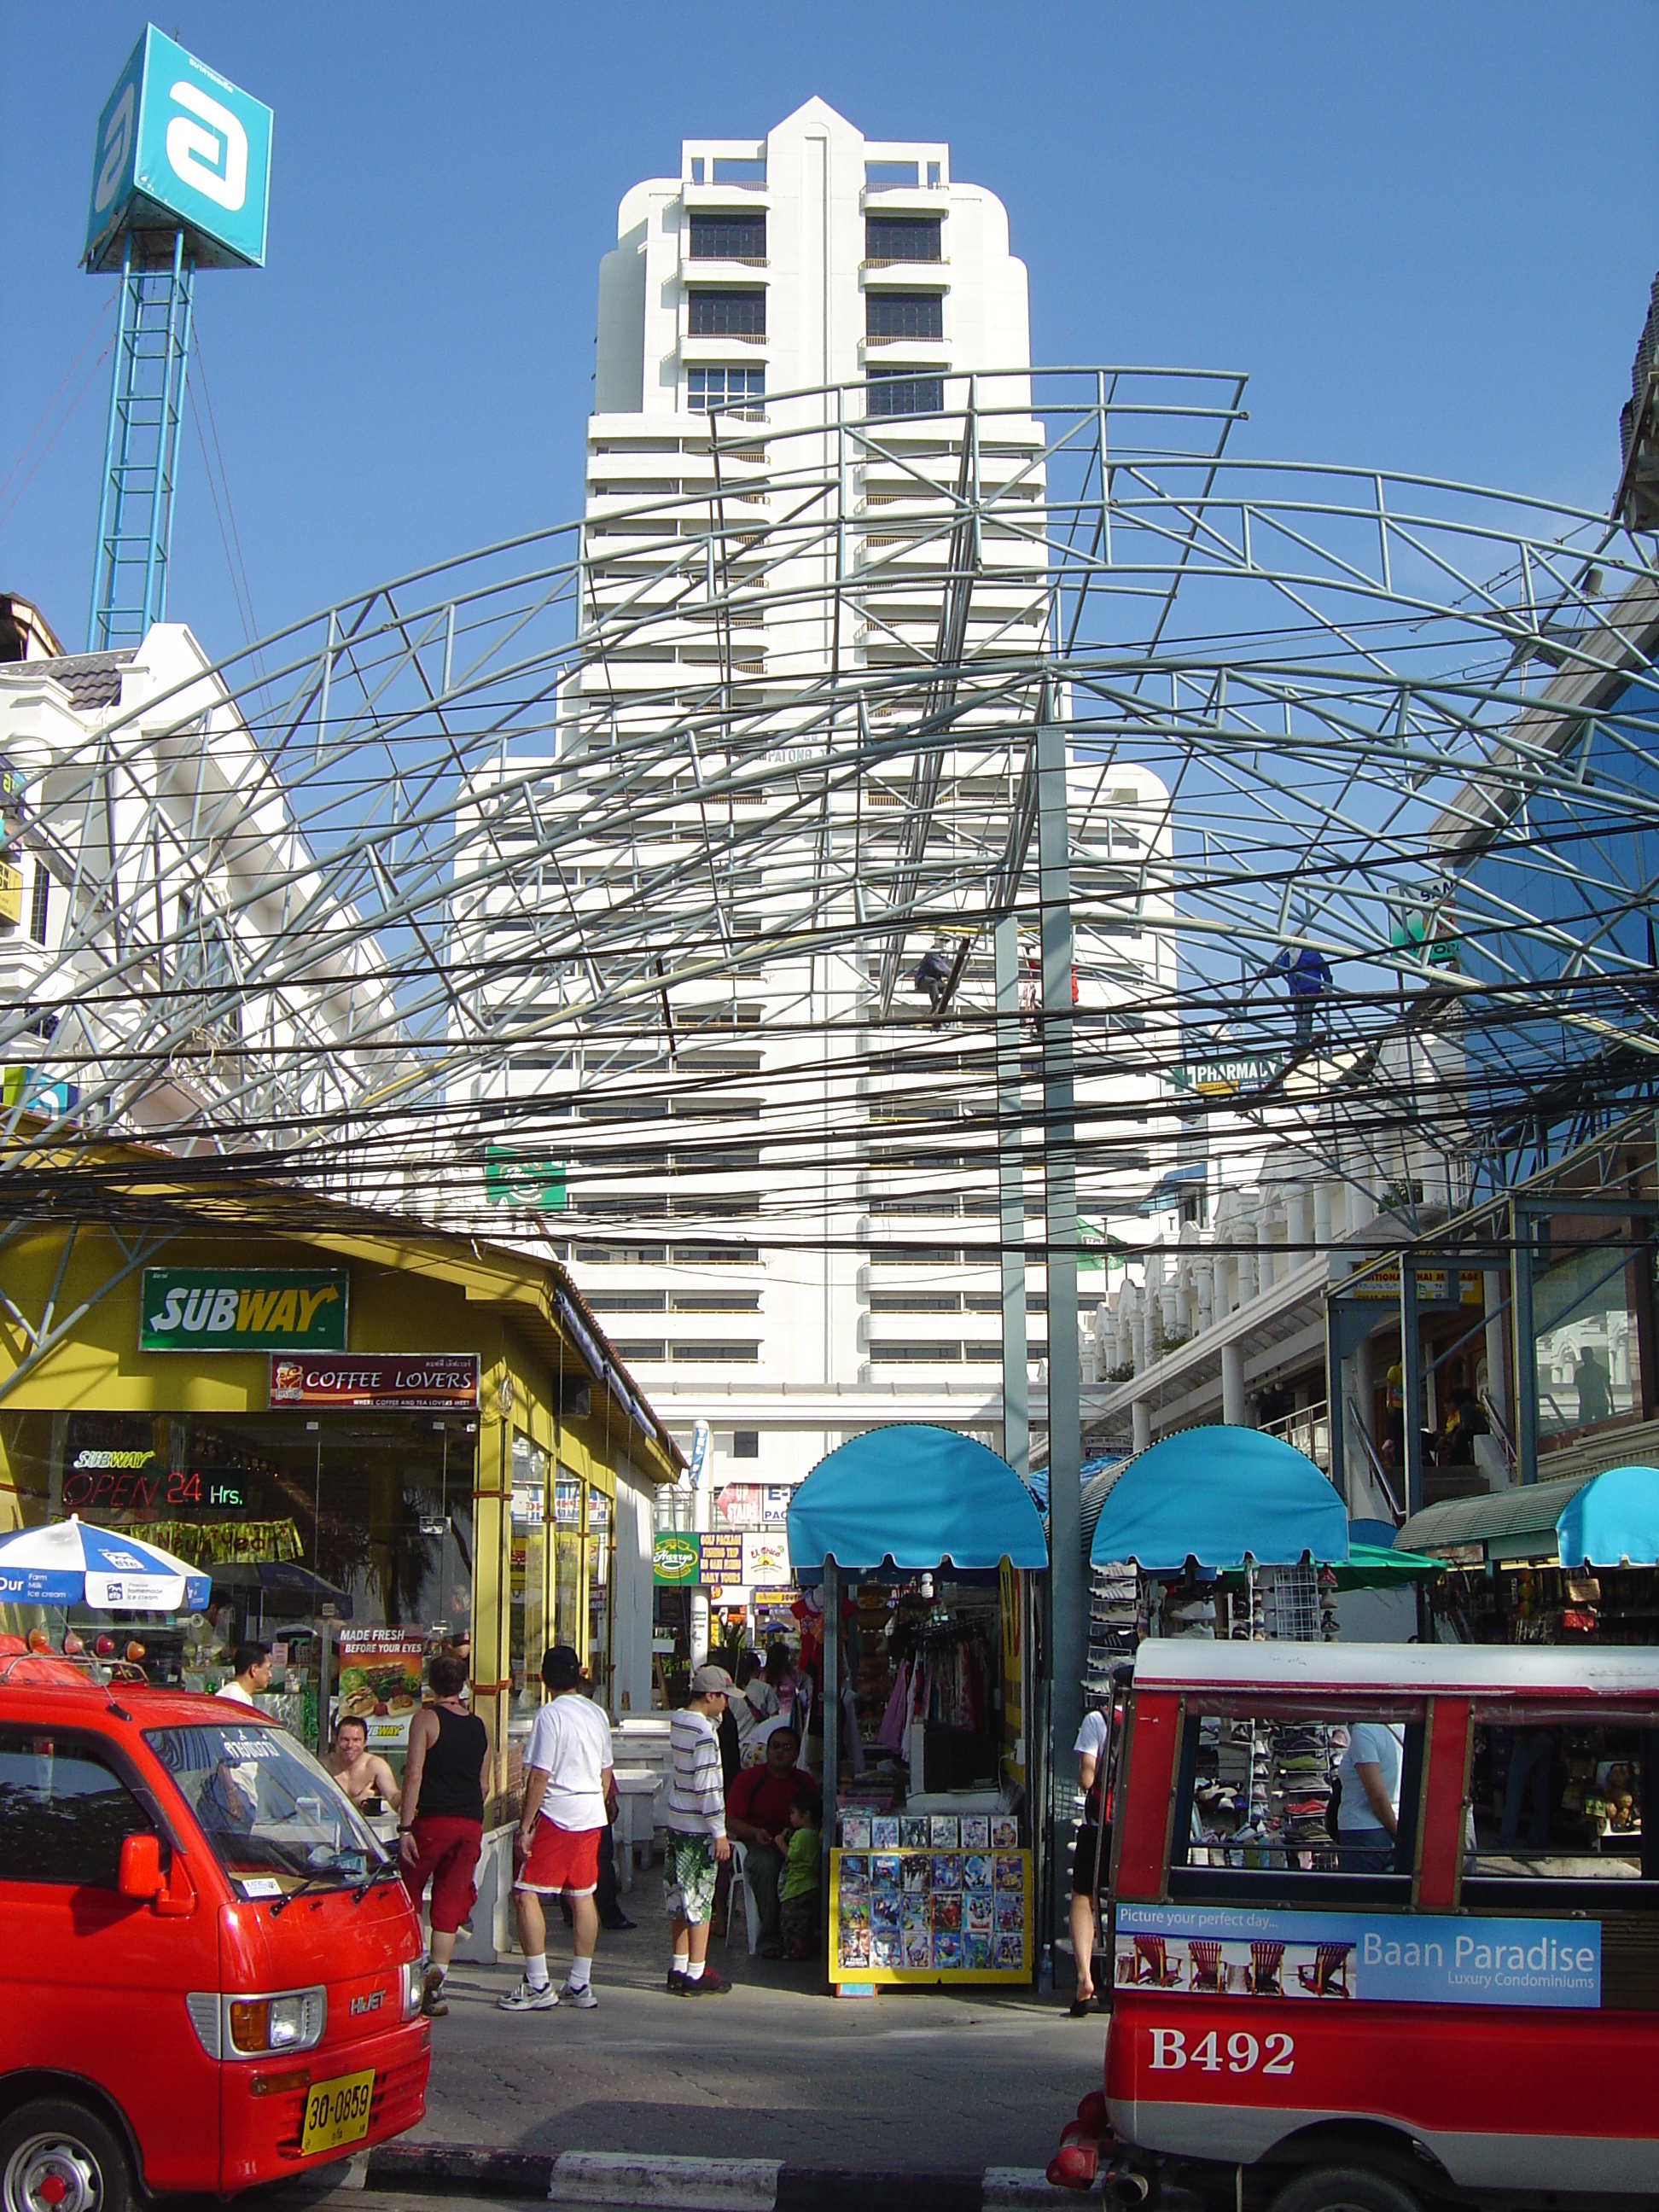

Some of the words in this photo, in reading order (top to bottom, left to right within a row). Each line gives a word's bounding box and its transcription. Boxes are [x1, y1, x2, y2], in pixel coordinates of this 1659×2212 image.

[1197, 1061, 1278, 1082] PHARMACY
[150, 1284, 339, 1332] SUBWAY
[306, 1371, 382, 1389] COFFEE
[395, 1371, 472, 1388] LOVERS
[73, 1450, 155, 1469] SUBWAY
[62, 1474, 160, 1506] OPEN
[166, 1473, 201, 1503] 24
[210, 1485, 243, 1505] Hrs.
[0, 1576, 24, 1591] Our
[341, 1629, 370, 1641] MADE
[372, 1629, 405, 1641] FRESH
[345, 1644, 376, 1653] BEFORE
[378, 1644, 400, 1653] YOUR
[402, 1644, 422, 1654] EYES
[1120, 1908, 1164, 1923] Picture
[1167, 1912, 1196, 1927] your
[1198, 1912, 1243, 1928] perfect
[1246, 1913, 1278, 1930] day...
[1364, 1933, 1443, 1967] Baan
[1455, 1936, 1595, 1972] Paradise
[1448, 1970, 1492, 1988] Luxury
[1494, 1972, 1594, 1988] Condominiums
[351, 1990, 386, 2016] HIJET
[1148, 2028, 1295, 2075] B492
[308, 2083, 370, 2131] 30-0859
